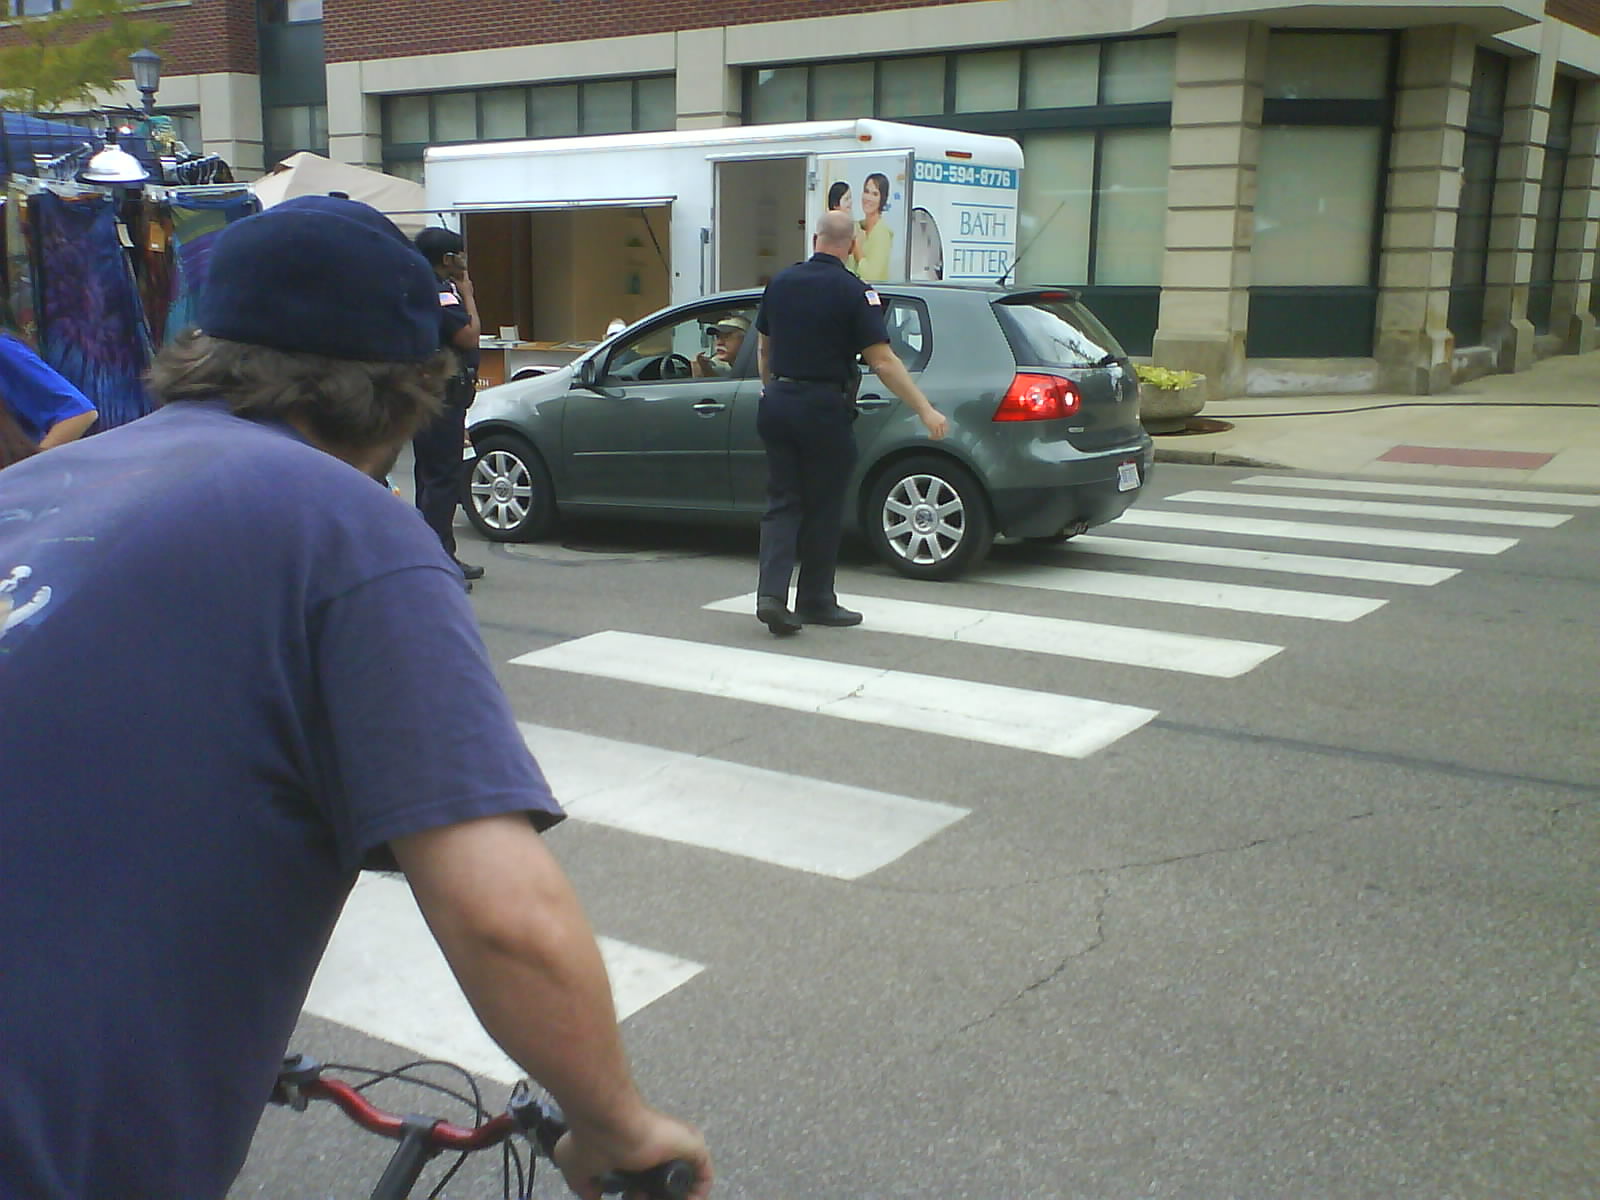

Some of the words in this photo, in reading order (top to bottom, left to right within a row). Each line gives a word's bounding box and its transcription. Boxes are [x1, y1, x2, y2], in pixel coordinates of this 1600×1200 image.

[914, 162, 1011, 187] 800-594-8776
[960, 211, 1006, 237] BATH
[953, 248, 1009, 273] FITTER
